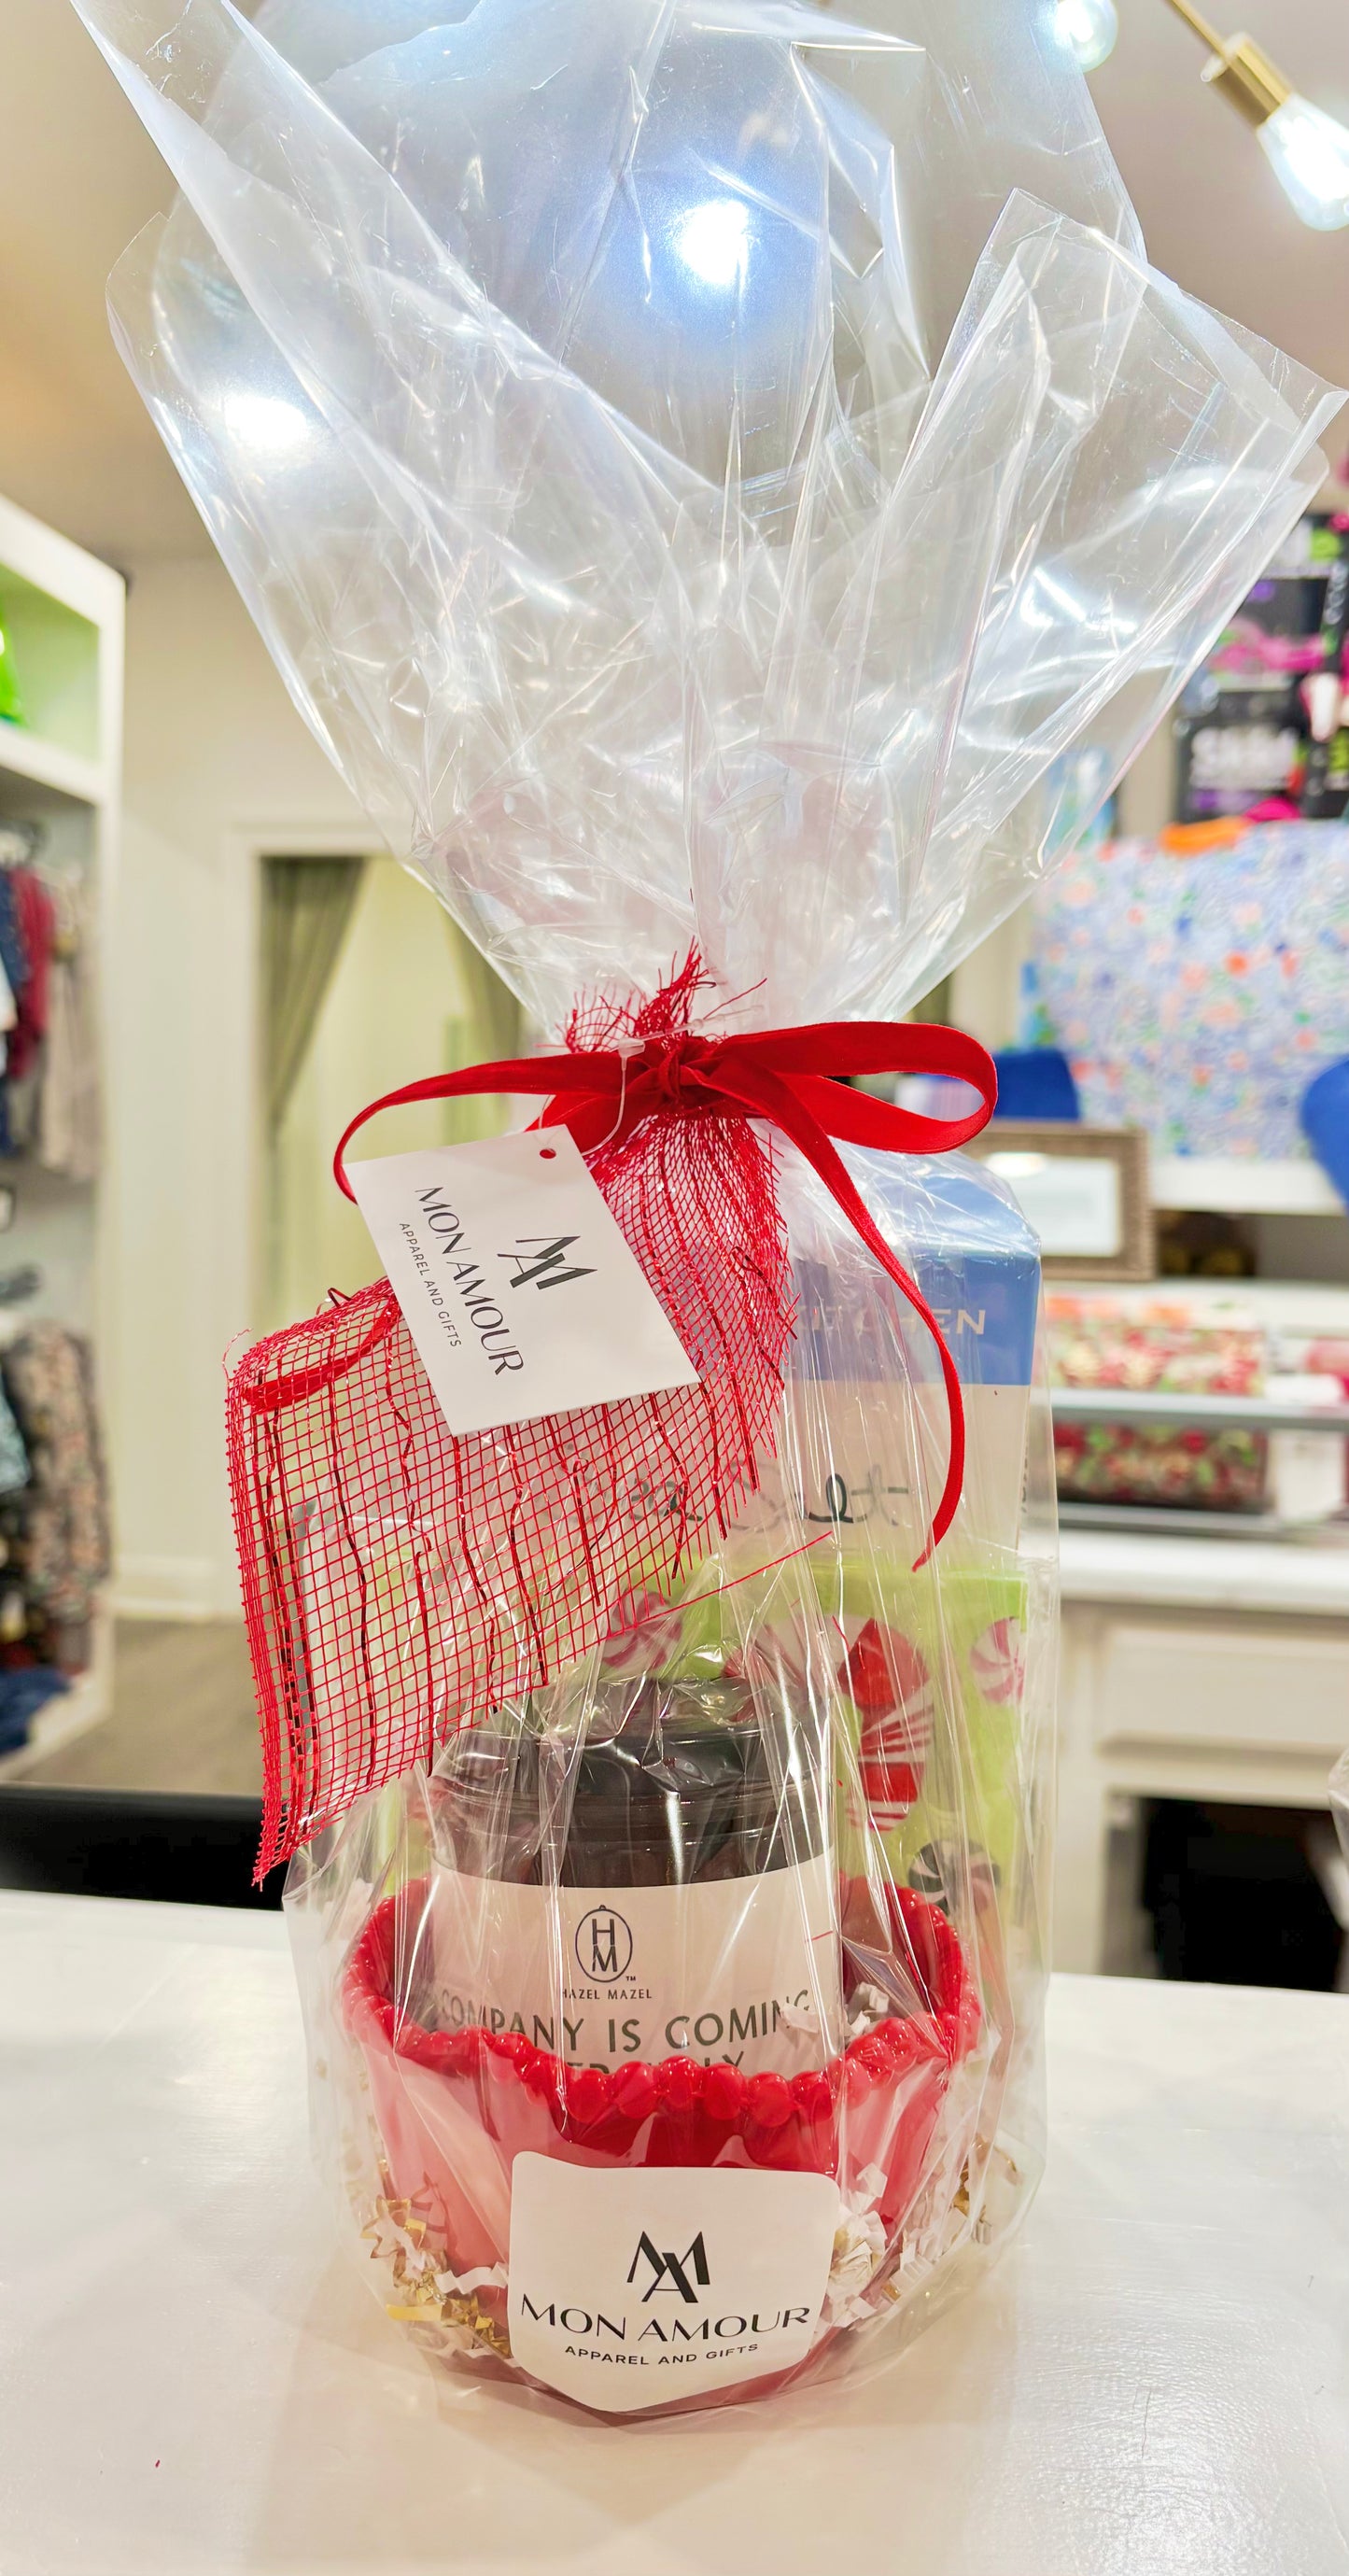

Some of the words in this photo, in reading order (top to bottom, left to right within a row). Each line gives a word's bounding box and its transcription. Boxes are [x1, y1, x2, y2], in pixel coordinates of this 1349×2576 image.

[399, 1222, 429, 1276] APPAREL
[424, 1280, 444, 1307] AND
[438, 1311, 462, 1347] GIFTS
[415, 1187, 471, 1255] MON
[446, 1260, 525, 1376] AMOUR
[442, 1989, 584, 2051] COMPANY
[609, 2019, 641, 2053] IS
[562, 1989, 600, 2000] HAZEL
[608, 1989, 653, 2000] MAZEL
[521, 2293, 626, 2341] MON
[638, 2307, 810, 2343] AMOUR
[565, 2345, 650, 2365] APPAREL
[658, 2353, 697, 2365] AND
[706, 2344, 759, 2359] GIFTS
